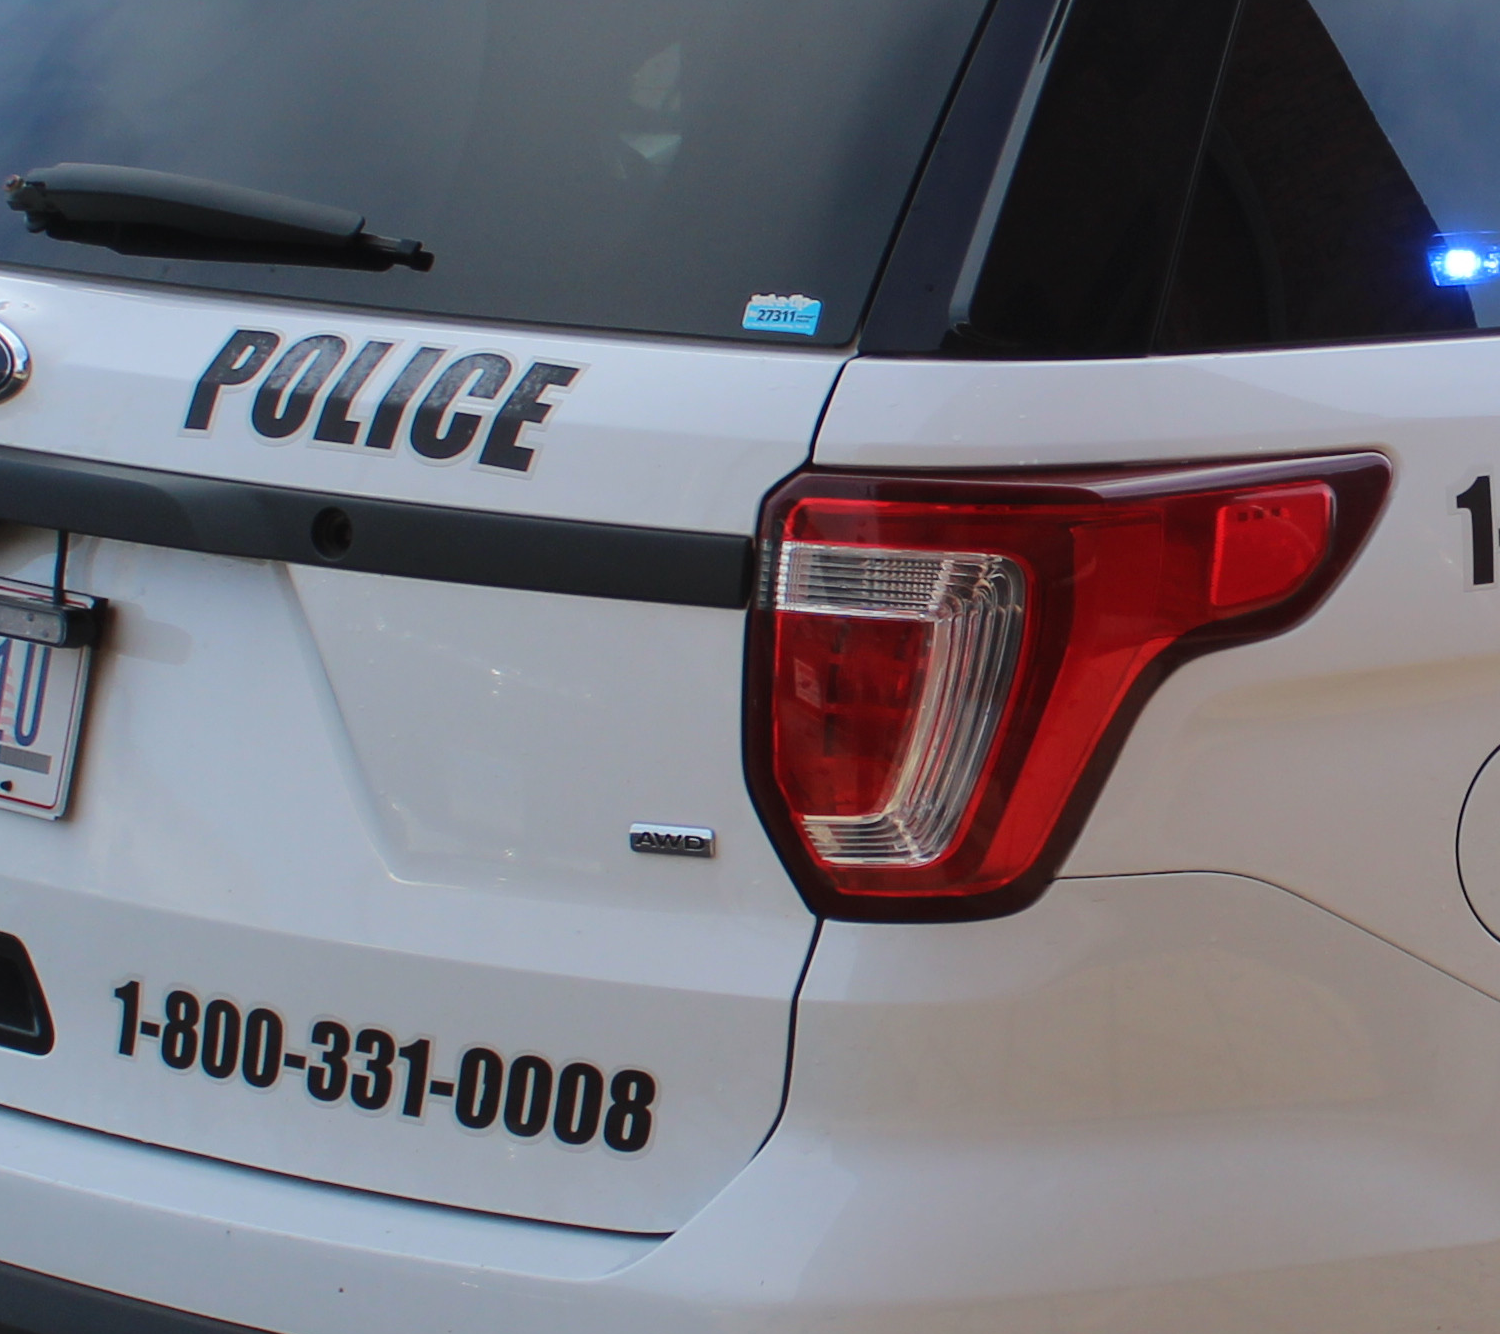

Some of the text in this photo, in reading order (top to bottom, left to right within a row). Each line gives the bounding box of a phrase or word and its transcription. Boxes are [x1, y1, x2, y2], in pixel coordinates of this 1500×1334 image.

[757, 309, 796, 323] 27311
[185, 327, 580, 474] POLICE
[636, 832, 706, 851] AWD
[114, 979, 656, 1154] 1-800-331-0008
